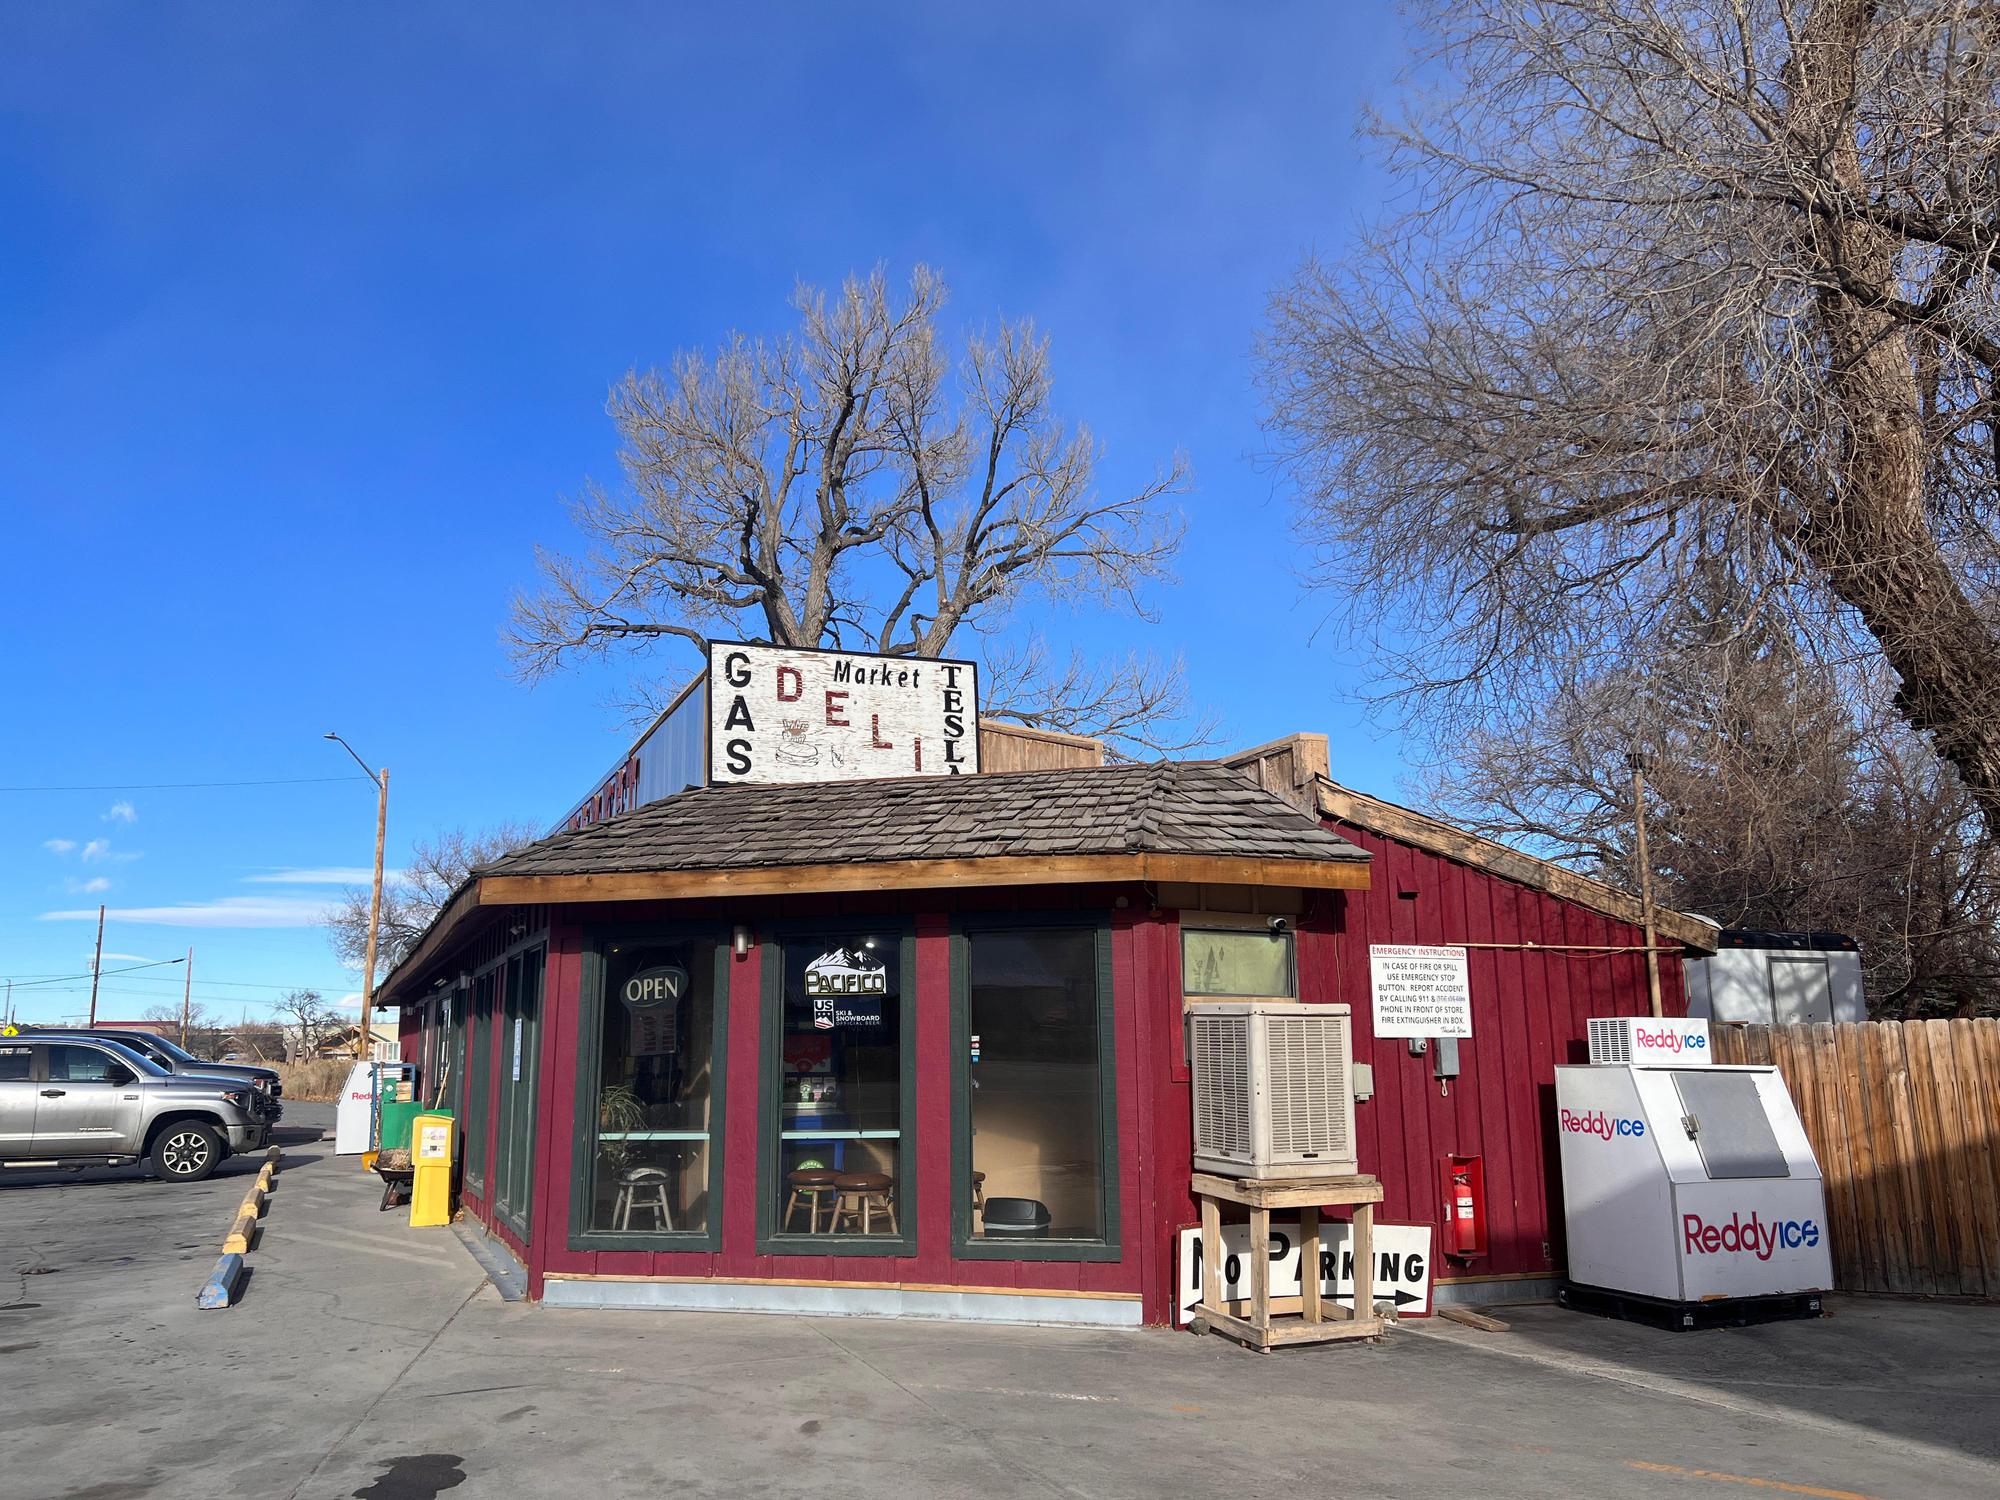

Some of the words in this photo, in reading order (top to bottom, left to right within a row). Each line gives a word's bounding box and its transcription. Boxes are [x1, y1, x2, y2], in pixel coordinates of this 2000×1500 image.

[834, 660, 920, 689] Market
[724, 652, 755, 775] GAS
[1372, 946, 1416, 955] EMERGENCY
[1418, 948, 1465, 957] INSTRUCTIONS
[1382, 962, 1389, 970] IN
[1391, 962, 1408, 970] CASE
[1409, 962, 1418, 970] OF
[1419, 963, 1431, 971] FIRE
[1433, 963, 1442, 971] OR
[1443, 963, 1458, 972] SPILL
[805, 970, 884, 995] PACIFICO
[1387, 973, 1400, 981] USE
[1401, 973, 1439, 982] EMERGENCY
[1440, 974, 1456, 982] STOP
[626, 976, 678, 1001] OPEN
[1410, 984, 1434, 992] REPORT
[1435, 985, 1464, 993] ACCIDENT
[1379, 994, 1389, 1002] BY
[1390, 994, 1417, 1003] CALLING
[1418, 994, 1429, 1003] 911
[1431, 995, 1436, 1003] &
[815, 1000, 833, 1010] US
[1380, 1005, 1403, 1013] PHONE
[1404, 1005, 1412, 1013] IN
[1413, 1005, 1433, 1014] FRONT
[1434, 1006, 1443, 1014] OF
[1381, 1016, 1395, 1024] FIRE
[1396, 1016, 1442, 1024] EXTINGUISHER
[1443, 1016, 1450, 1024] IN
